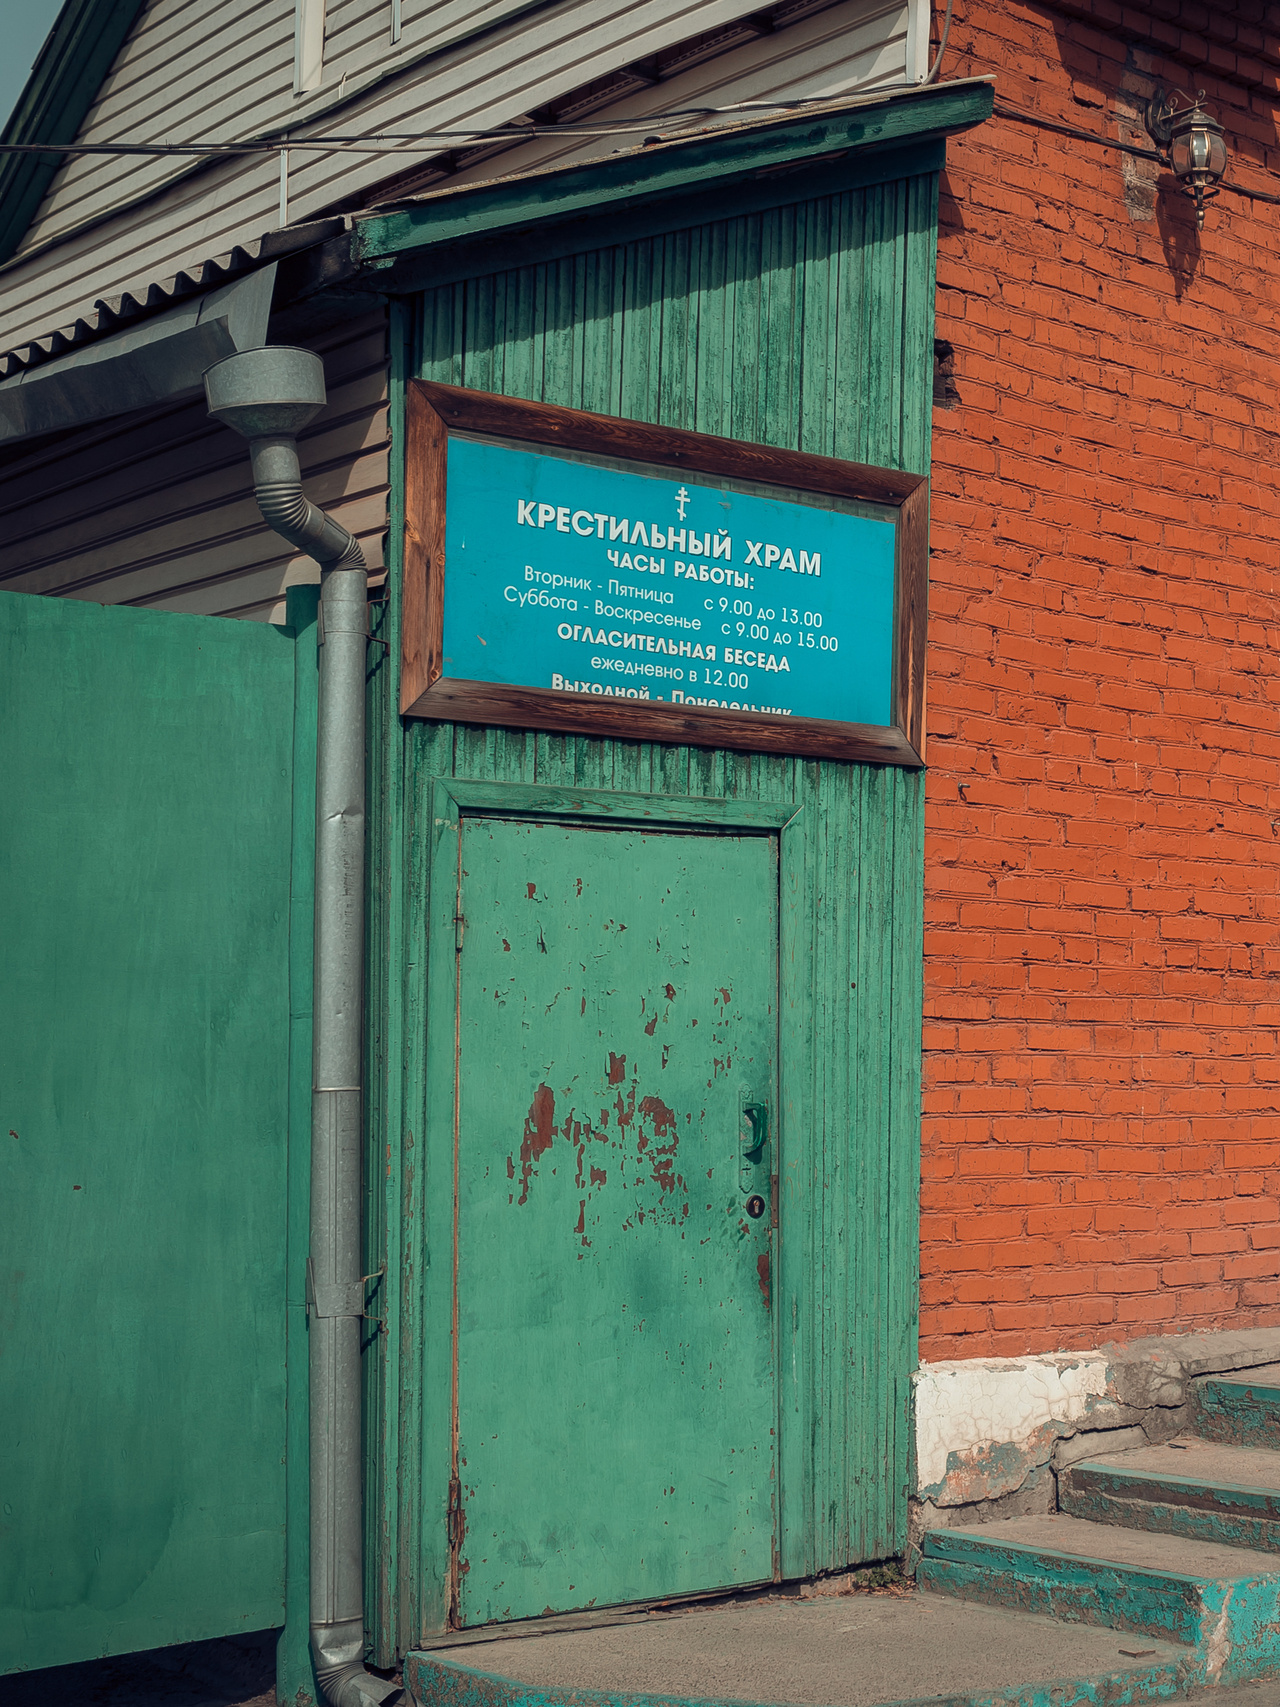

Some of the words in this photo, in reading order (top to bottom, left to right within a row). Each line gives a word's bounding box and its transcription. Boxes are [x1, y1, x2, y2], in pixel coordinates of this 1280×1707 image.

[517, 499, 732, 561] КРЕСТИЛЬНЫЙ
[744, 539, 821, 577] ХРАМ
[606, 549, 666, 576] ЧАСЫ
[674, 560, 755, 590] РАБОТЫ:
[503, 585, 578, 612] Суббота
[594, 598, 702, 631] Воскресенье
[721, 623, 731, 635] с
[735, 621, 769, 641] 9.00
[773, 632, 792, 646] до
[797, 631, 839, 652] 15.00
[524, 565, 592, 591] Вторник
[608, 579, 674, 604] Пятница
[703, 598, 714, 611] с
[718, 597, 753, 617] 9.00
[756, 607, 776, 621] до
[781, 607, 823, 628] 13.00
[557, 622, 717, 662] ОГЛАСИТЕЛЬНАЯ
[724, 647, 791, 674] БЕСЕДА
[590, 656, 684, 681] ежедневно
[689, 670, 698, 682] в
[704, 667, 749, 690] 12.00
[551, 673, 650, 701] Выходной
